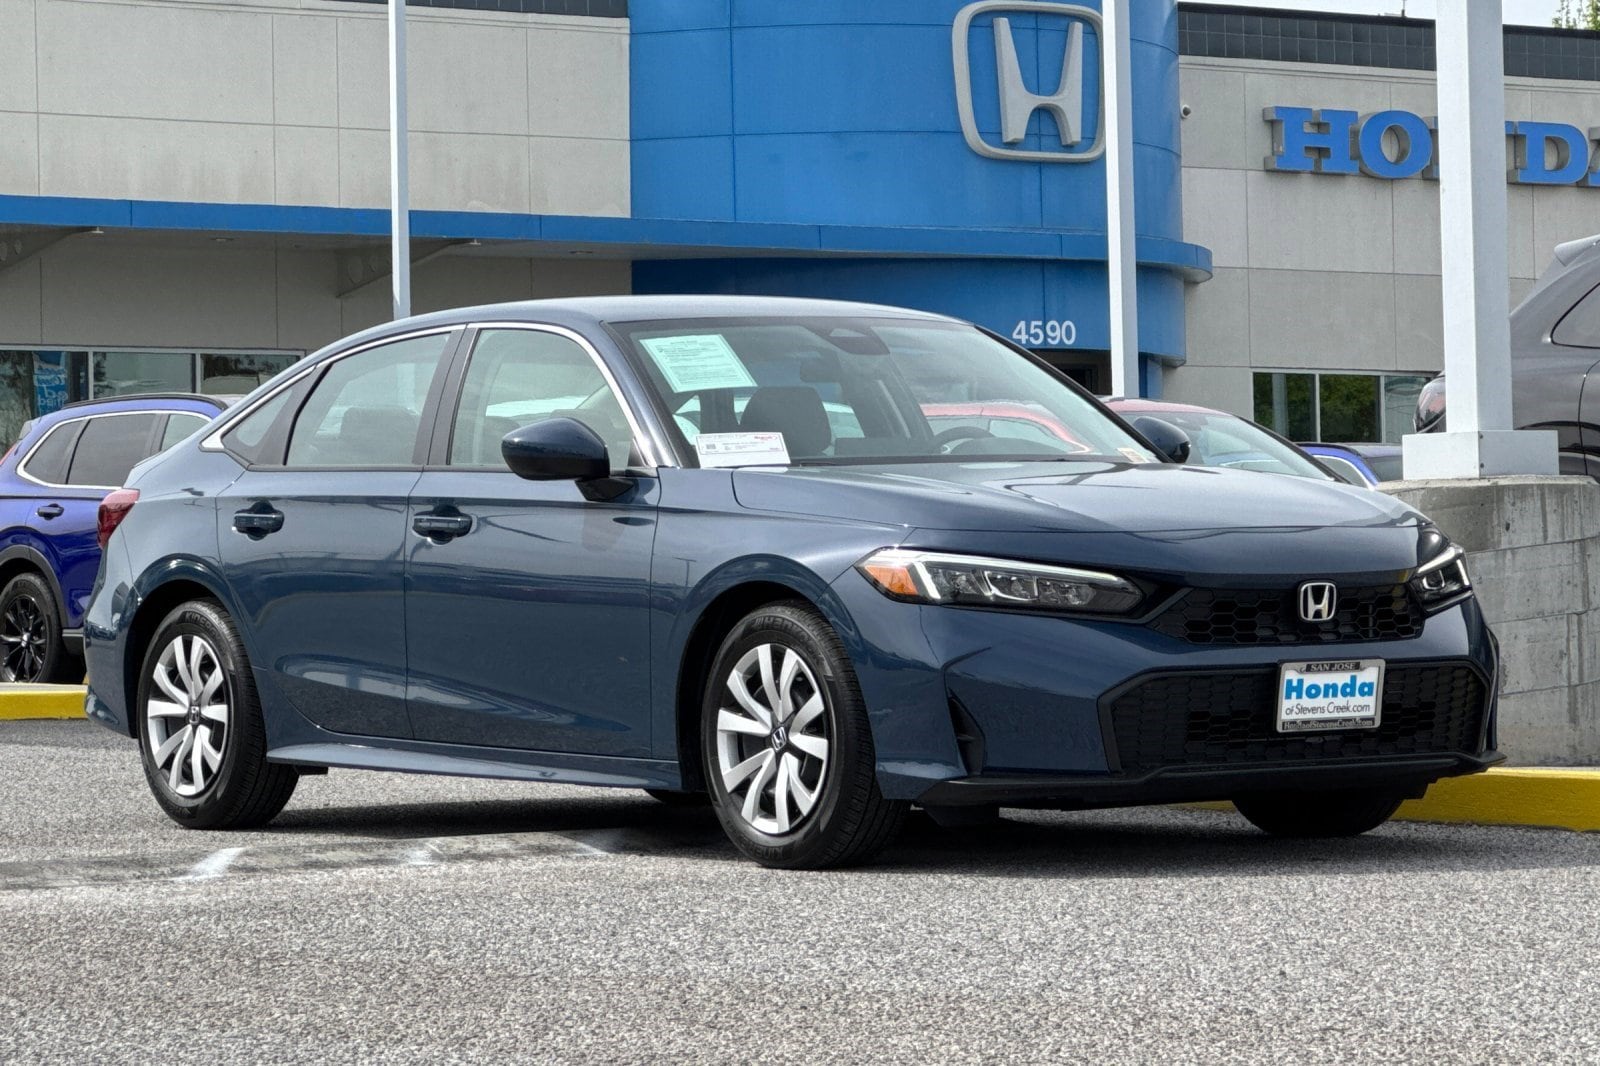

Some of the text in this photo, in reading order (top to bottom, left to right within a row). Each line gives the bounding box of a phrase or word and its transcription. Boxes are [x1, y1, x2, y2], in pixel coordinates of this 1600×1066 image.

[1263, 104, 1600, 188] HOD
[1012, 320, 1076, 345] 4590
[1310, 662, 1356, 672] SAN JOSE
[1285, 674, 1375, 700] Honda
[1285, 706, 1295, 716] of
